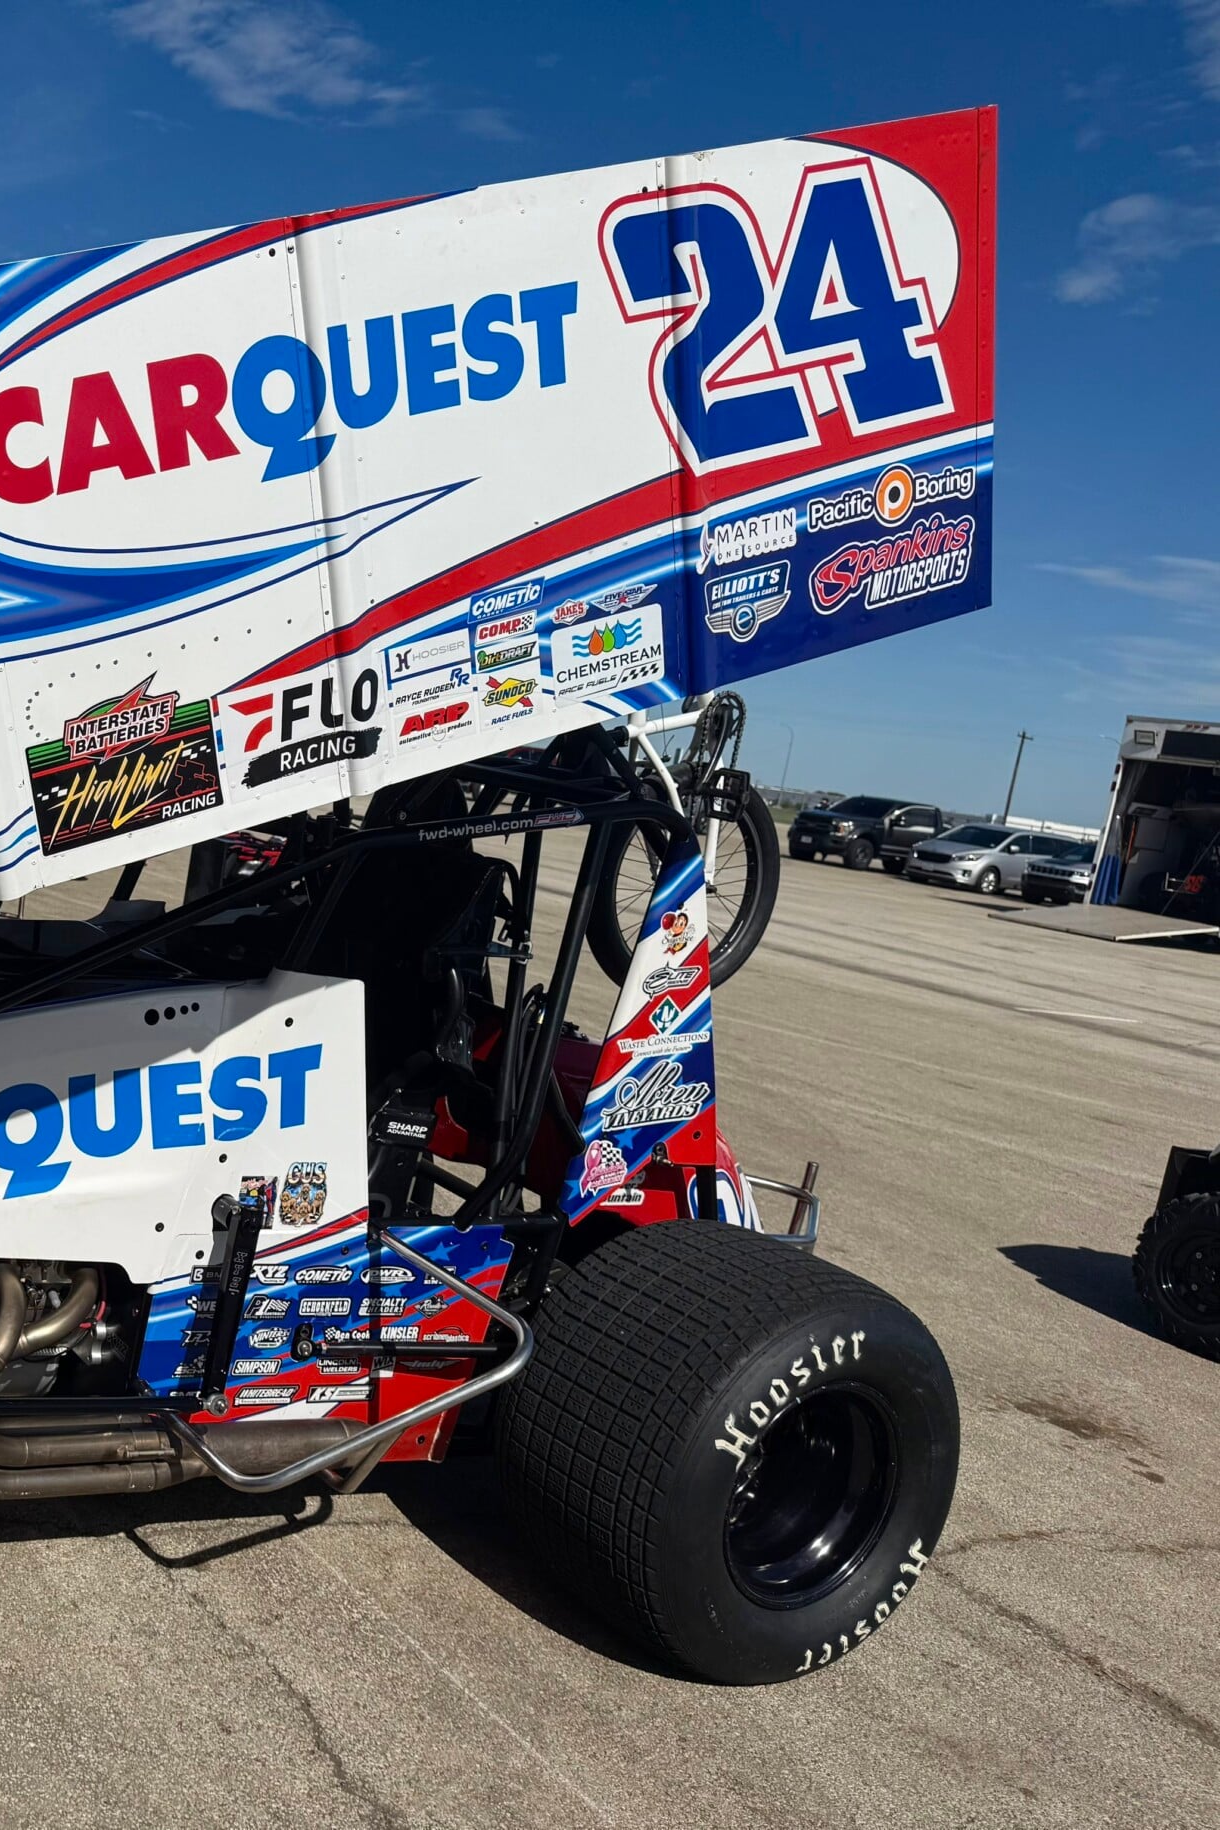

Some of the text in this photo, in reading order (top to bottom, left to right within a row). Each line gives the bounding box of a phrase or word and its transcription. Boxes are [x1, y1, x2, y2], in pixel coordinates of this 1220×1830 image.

[600, 158, 954, 476] 24
[812, 493, 872, 527] Pacific
[915, 468, 973, 498] Boring
[717, 511, 793, 545] MARTIN
[717, 535, 794, 560] ONE SOURCE
[814, 519, 970, 606] Spankins
[711, 568, 781, 601] ELLIOTT'S
[870, 549, 967, 602] MOTORSPORTS
[472, 583, 541, 617] COMETIC
[554, 602, 584, 621] JAKES
[478, 619, 522, 640] COMP
[412, 640, 466, 662] HOOSIER
[556, 644, 662, 683] CHEMSTREAM
[395, 682, 456, 705] RAYCE RUDEEN
[487, 681, 534, 703] SUNOCO
[558, 683, 584, 696] RACE
[281, 668, 378, 742] FLO
[491, 708, 534, 725] RACE FUELS
[68, 701, 171, 740] INTERSTATE
[399, 701, 470, 737] ARP
[74, 718, 166, 756] BATTERIES
[399, 720, 473, 746] automotive products
[280, 735, 357, 772] RACING
[162, 791, 217, 820] RACING
[418, 818, 533, 842] fwd-wheel.com
[620, 1032, 709, 1051] WASTE CONNECTIONS
[388, 1121, 429, 1133] SHARP
[604, 1103, 699, 1130] VINEYARDS
[386, 1129, 427, 1139] ADVANTAGE
[287, 1162, 327, 1184] GUS
[607, 1194, 642, 1203] untain
[249, 1265, 290, 1281] XYZ
[295, 1267, 353, 1283] COMETIC
[301, 1300, 349, 1313] SCHOENFELD
[361, 1298, 408, 1307] SPECIALTY
[380, 1326, 418, 1339] KINSLER
[234, 1361, 278, 1374] SIMPSON
[714, 1329, 866, 1473] Hoosier
[795, 1538, 929, 1672] Hoosier
